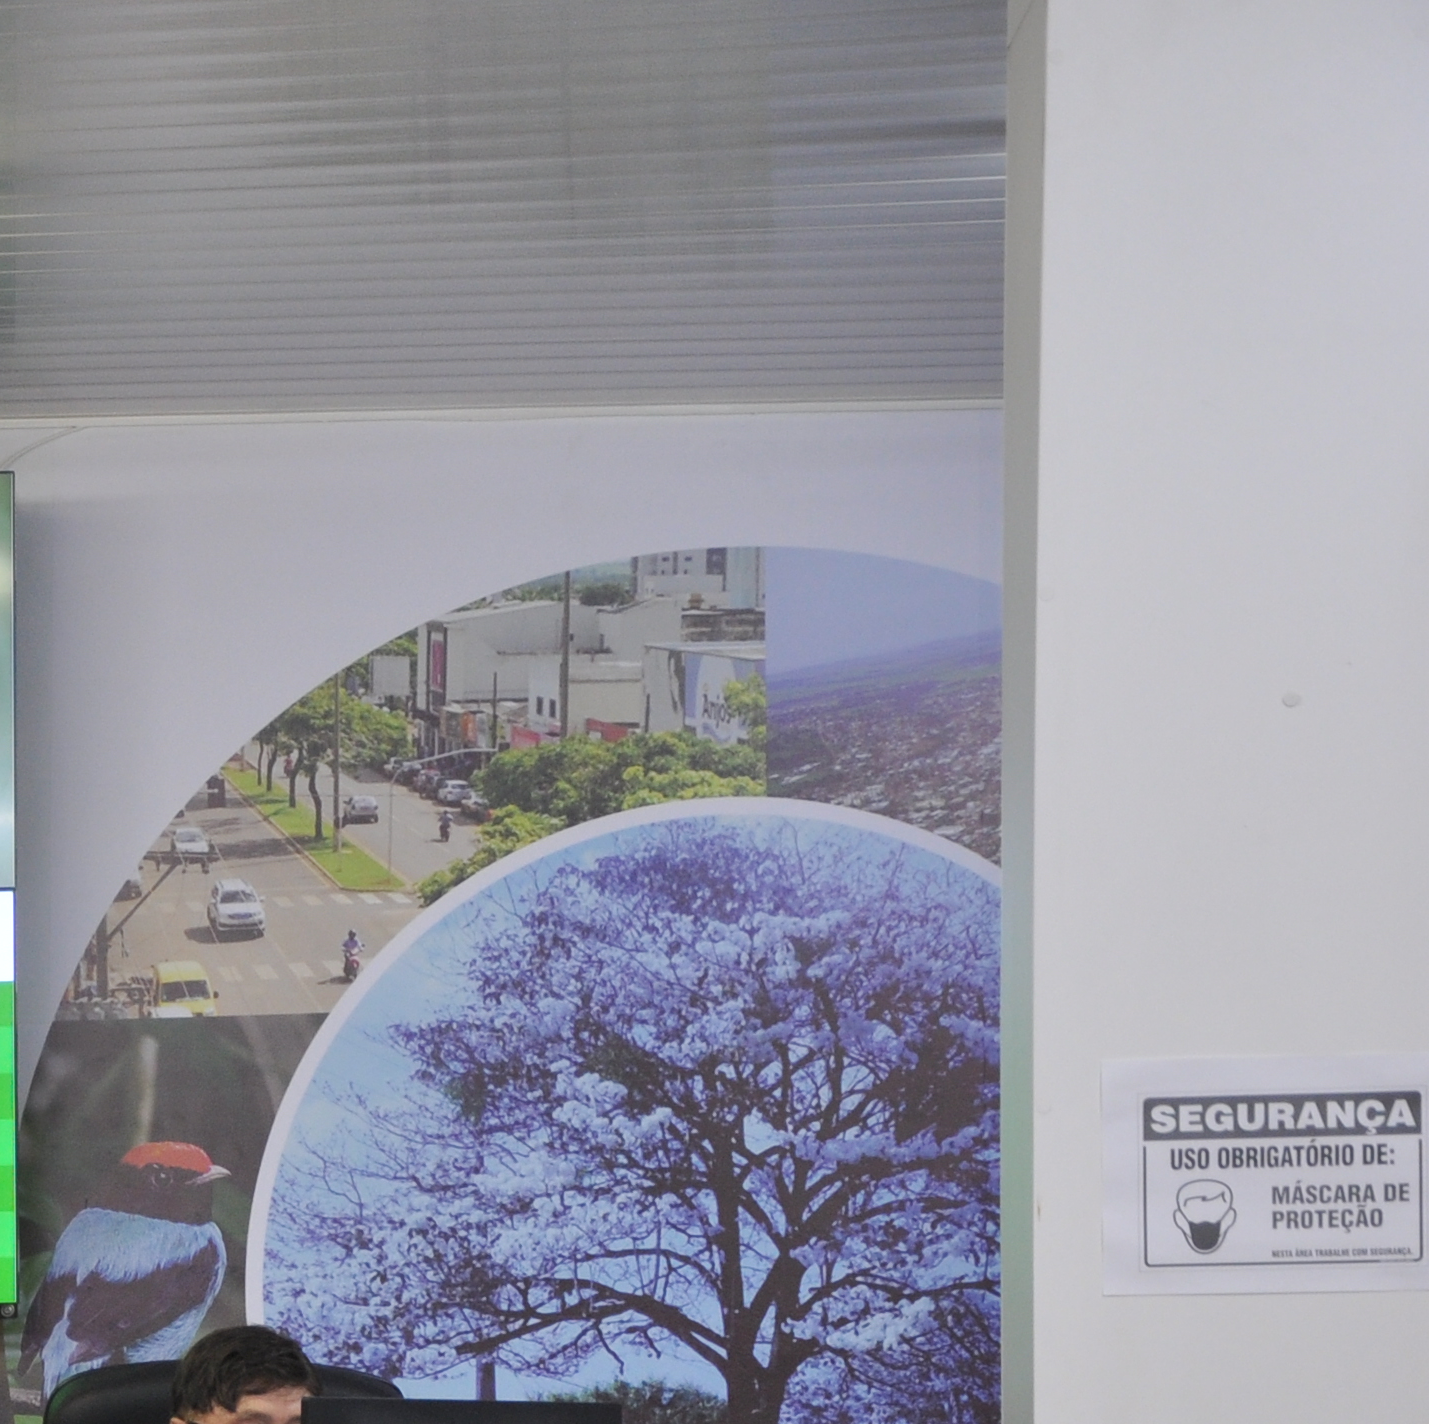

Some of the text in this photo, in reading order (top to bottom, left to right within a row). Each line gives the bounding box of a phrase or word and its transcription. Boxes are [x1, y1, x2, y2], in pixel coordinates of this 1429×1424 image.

[1150, 1098, 1417, 1135] SEGURANÇA
[1170, 1139, 1395, 1170] USO OBRIGATÓRIO DE:
[1271, 1180, 1410, 1205] MÁSCARA DE
[1271, 1204, 1384, 1233] PROTEÇÃO
